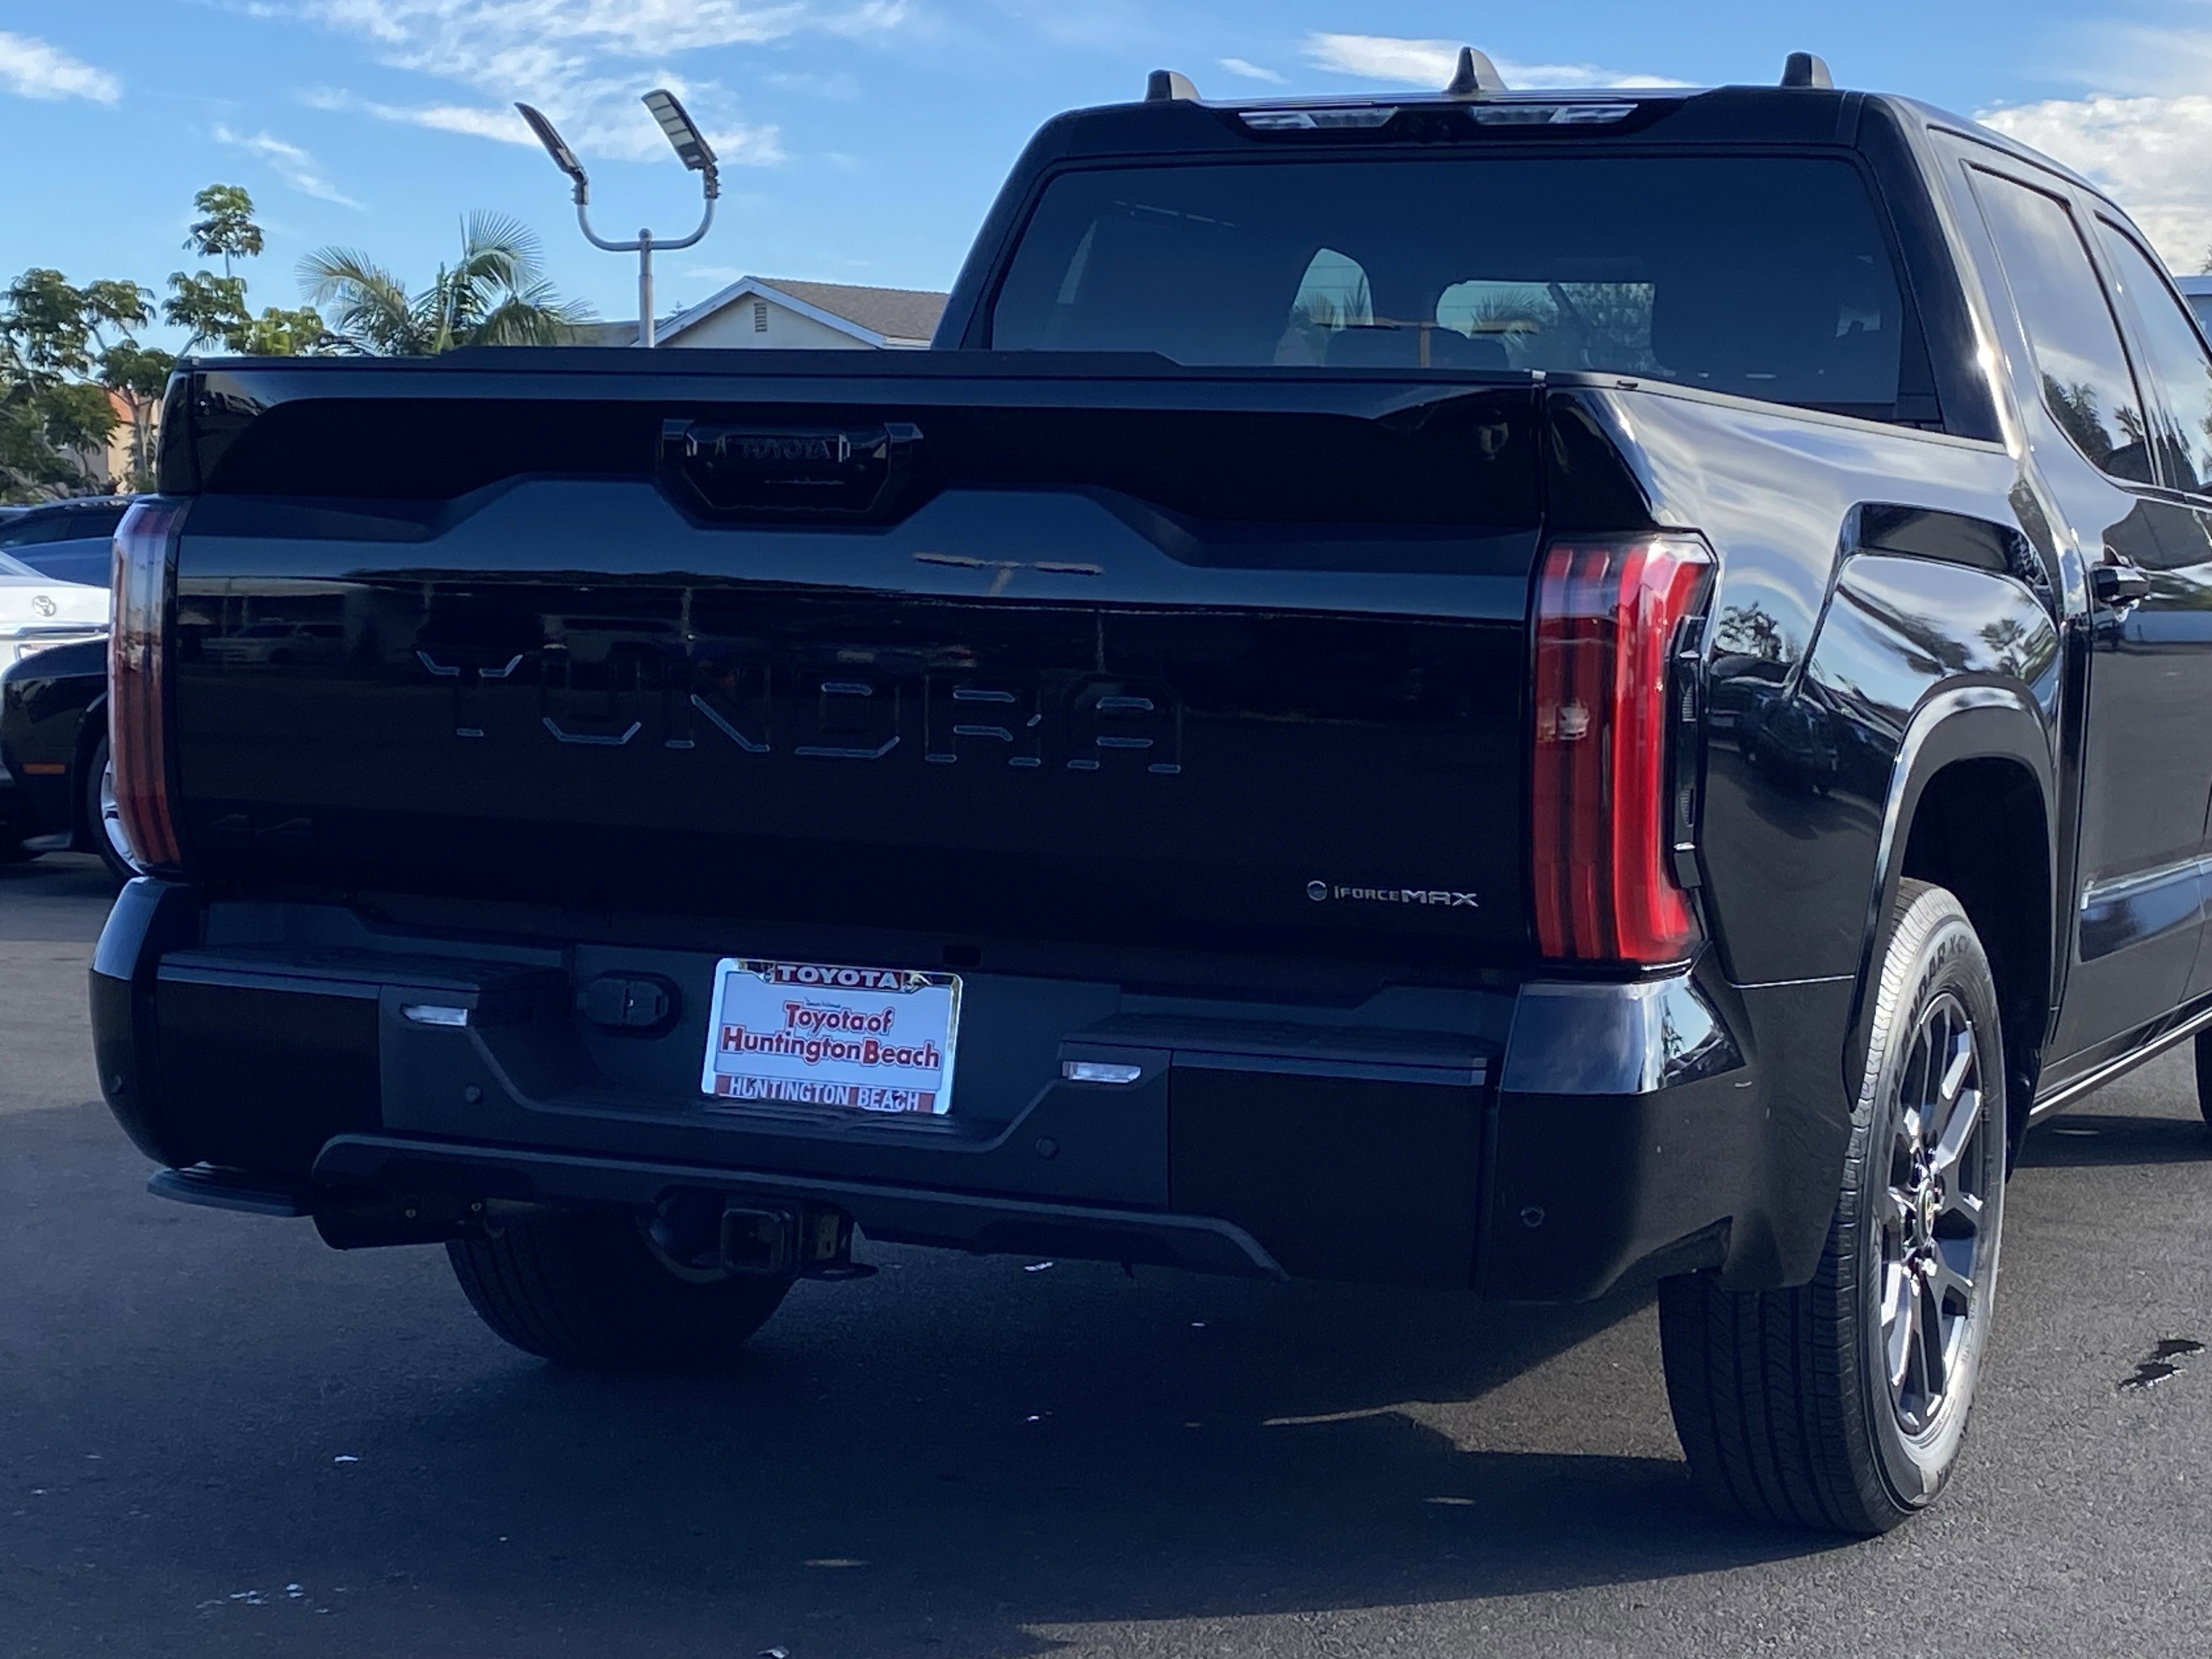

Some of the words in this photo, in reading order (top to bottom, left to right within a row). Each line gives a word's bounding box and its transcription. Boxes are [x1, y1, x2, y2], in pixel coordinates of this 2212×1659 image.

[417, 650, 1183, 775] TUNDRA
[1401, 889, 1479, 907] MAX
[777, 965, 899, 988] TOYOTA
[730, 1077, 849, 1105] HUNTINGTON
[857, 1090, 919, 1111] BEACH
